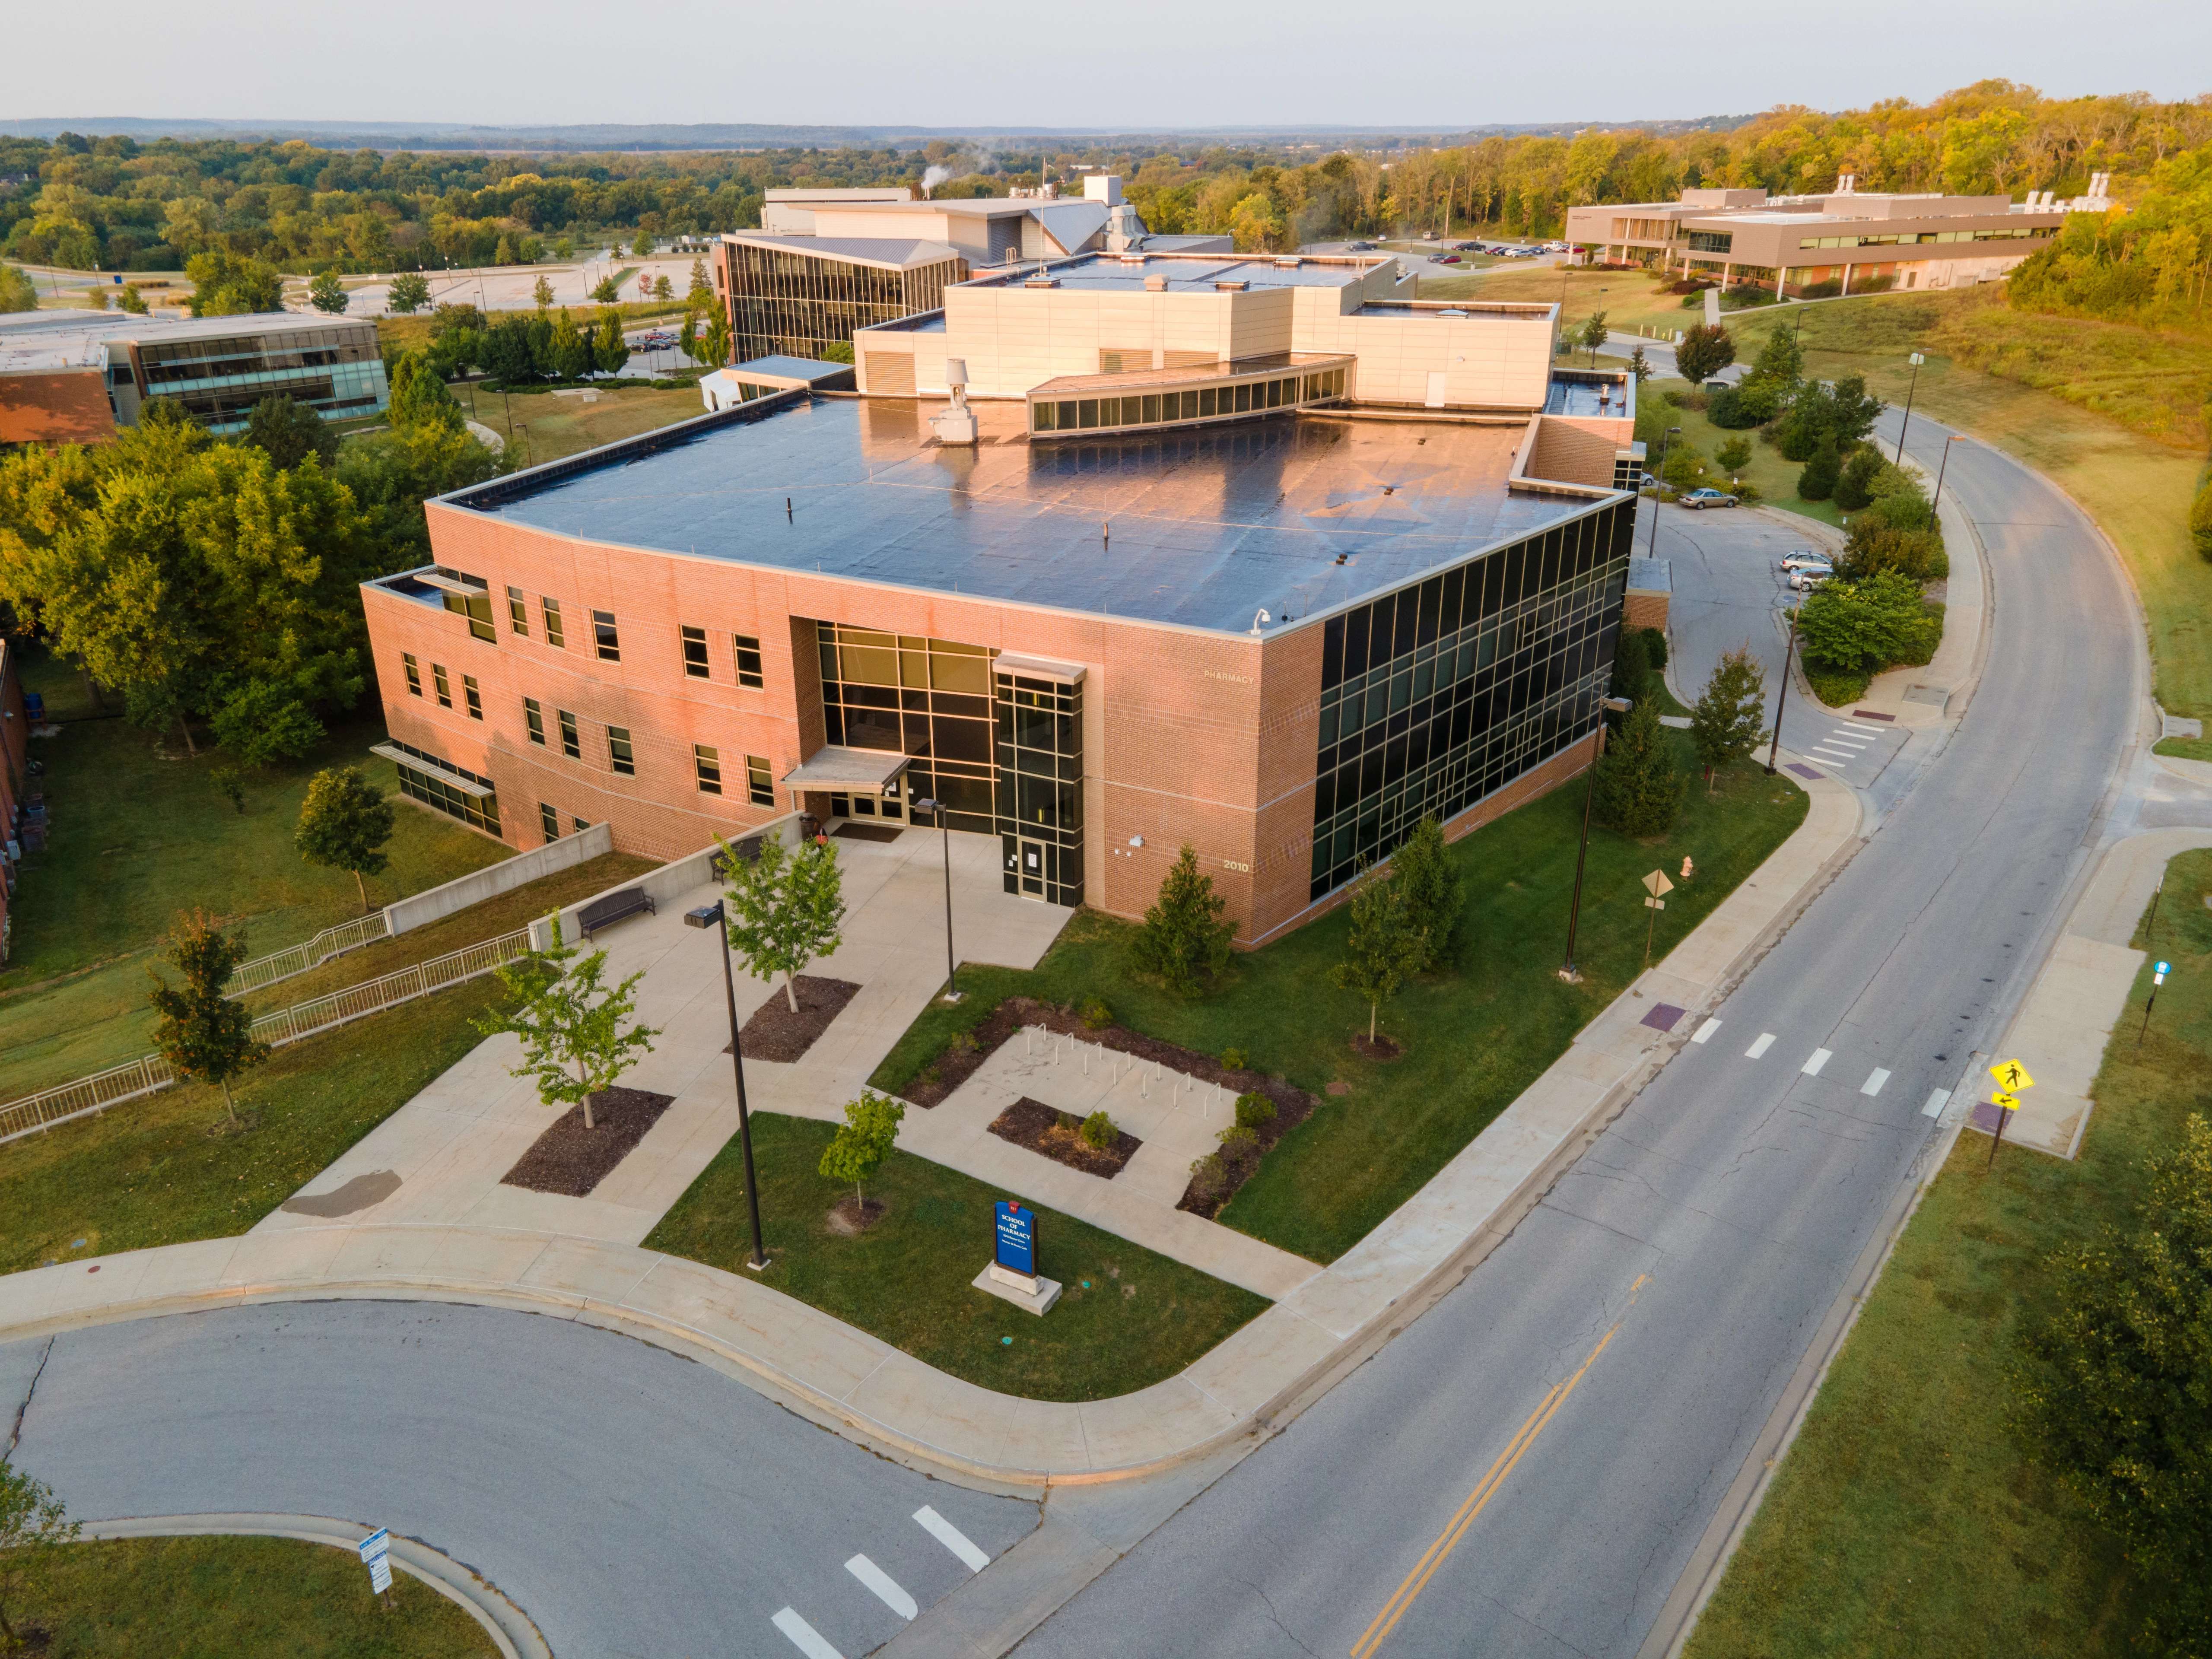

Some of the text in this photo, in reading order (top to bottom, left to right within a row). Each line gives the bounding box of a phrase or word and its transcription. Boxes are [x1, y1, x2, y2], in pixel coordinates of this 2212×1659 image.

[1205, 671, 1254, 684] PHARMACY
[1224, 860, 1249, 872] 2010
[1002, 1214, 1026, 1227] SCHOOL
[998, 1224, 1030, 1239] PHARMACY
[369, 1551, 386, 1564] NOTICE
